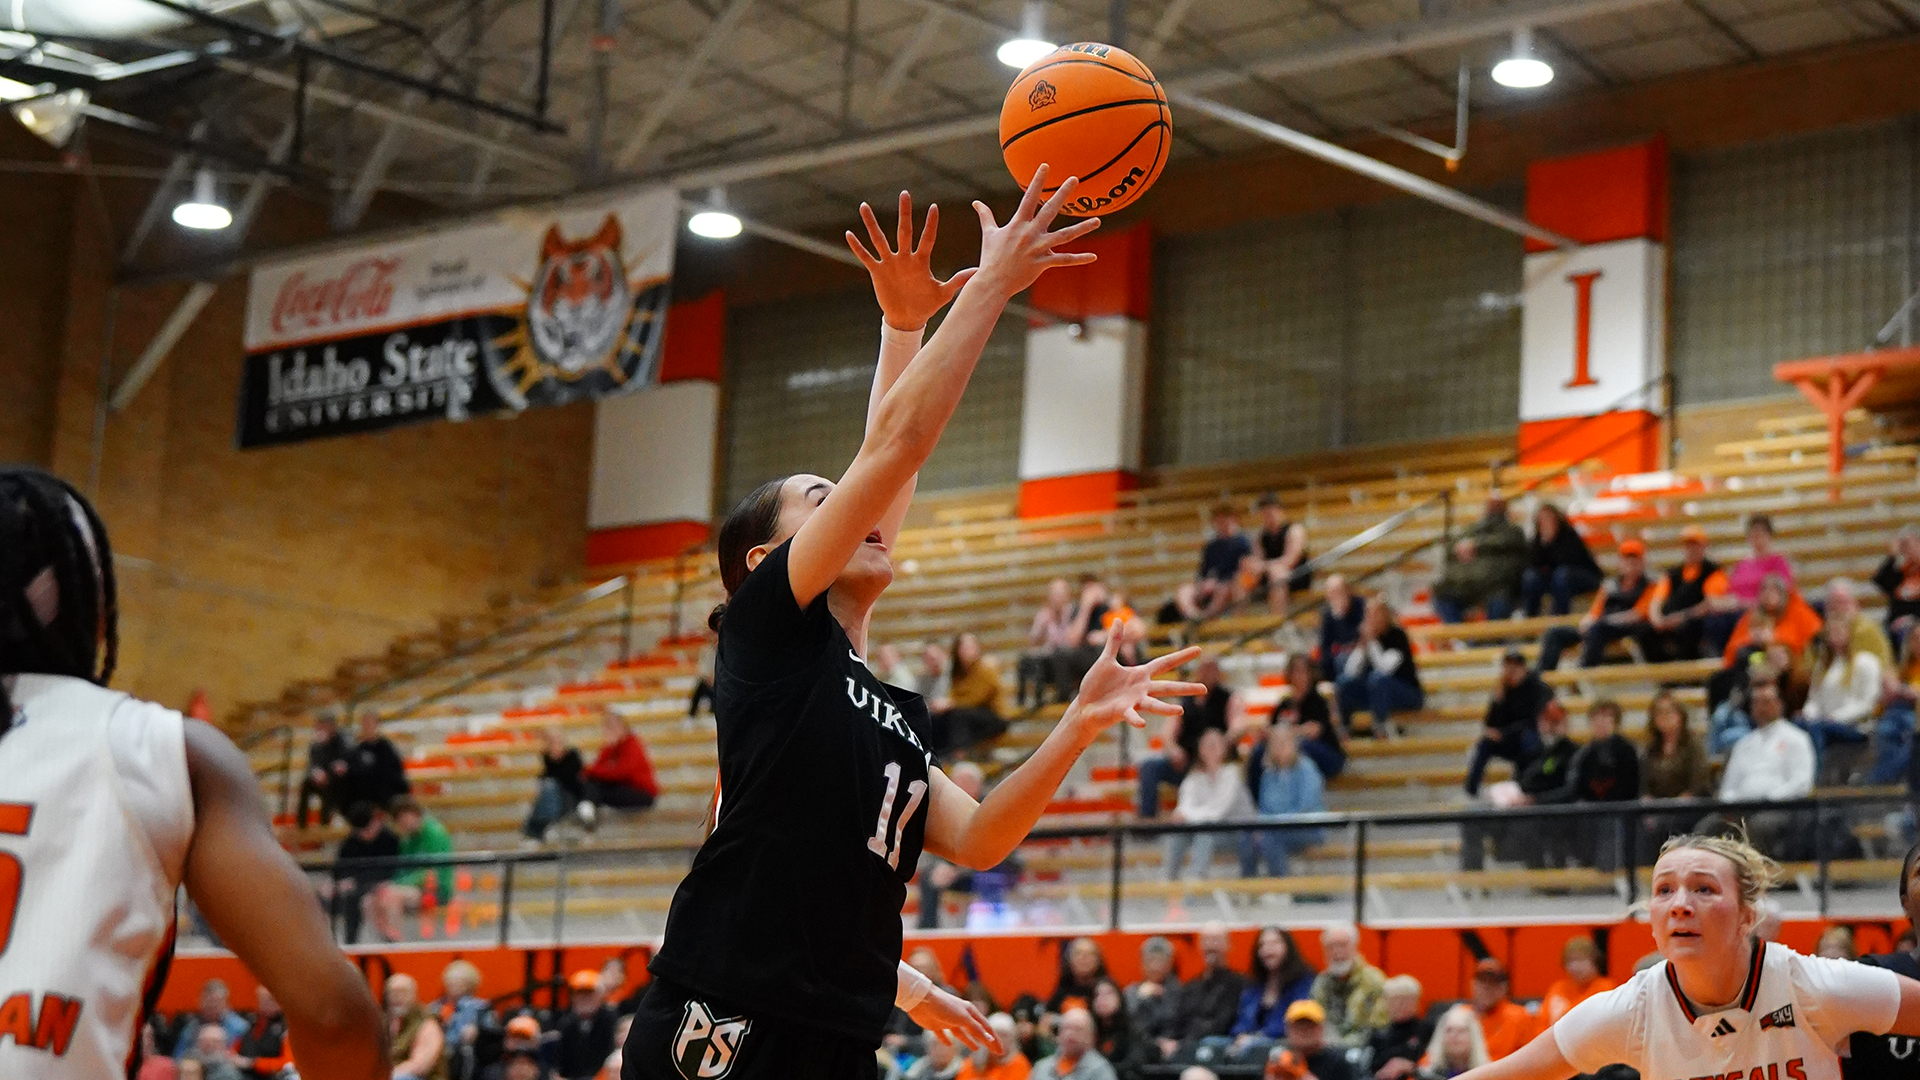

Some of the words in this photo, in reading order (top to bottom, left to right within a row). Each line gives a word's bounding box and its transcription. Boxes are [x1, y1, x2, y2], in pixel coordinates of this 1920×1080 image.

[1040, 166, 1146, 214] ilson
[1563, 269, 1604, 389] I
[268, 345, 371, 406] Idaho
[379, 332, 478, 387] State
[846, 677, 931, 773] VIKI
[867, 762, 928, 871] 11
[676, 1000, 748, 1078] PS
[1772, 1004, 1793, 1025] SKY
